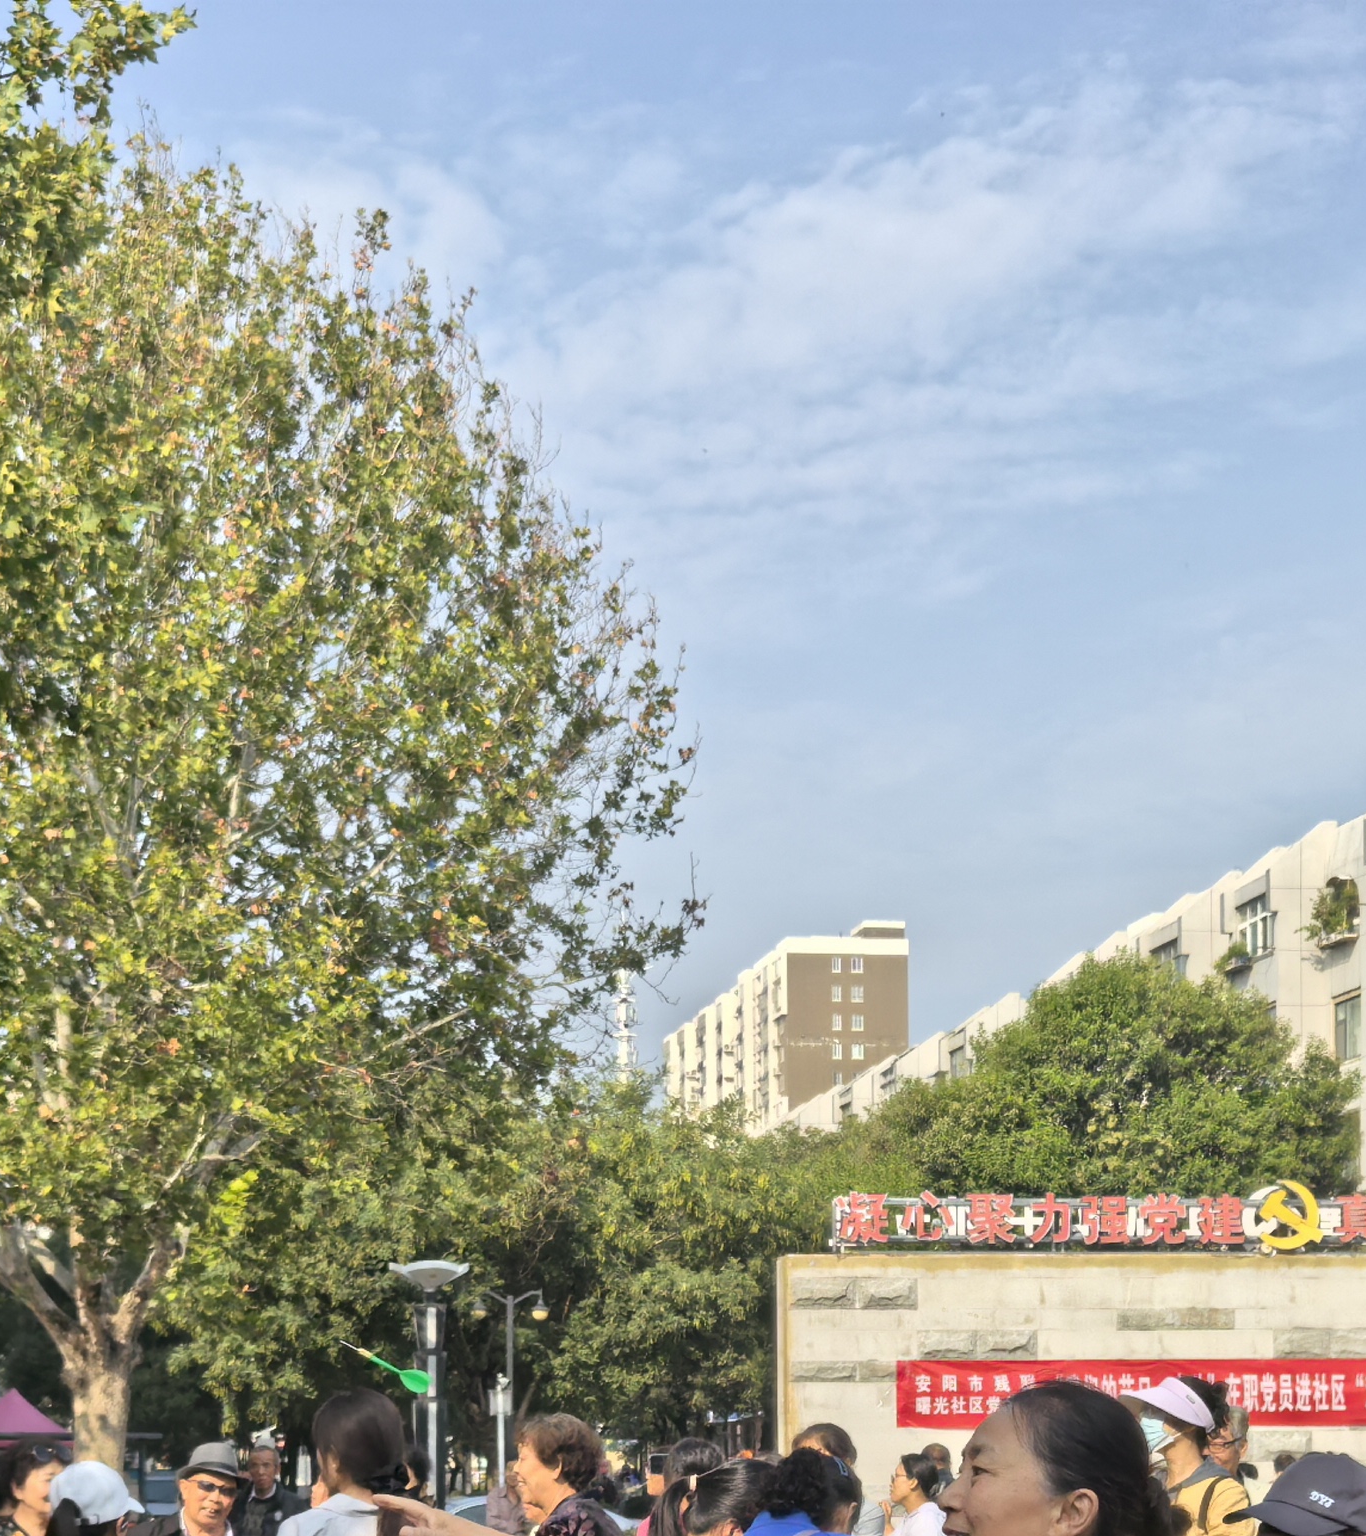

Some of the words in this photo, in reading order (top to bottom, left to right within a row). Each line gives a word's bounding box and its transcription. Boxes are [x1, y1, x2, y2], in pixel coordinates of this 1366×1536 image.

[836, 1191, 1247, 1245] 凝心聚力强党建
[915, 1396, 1009, 1415] 曙光社区党
